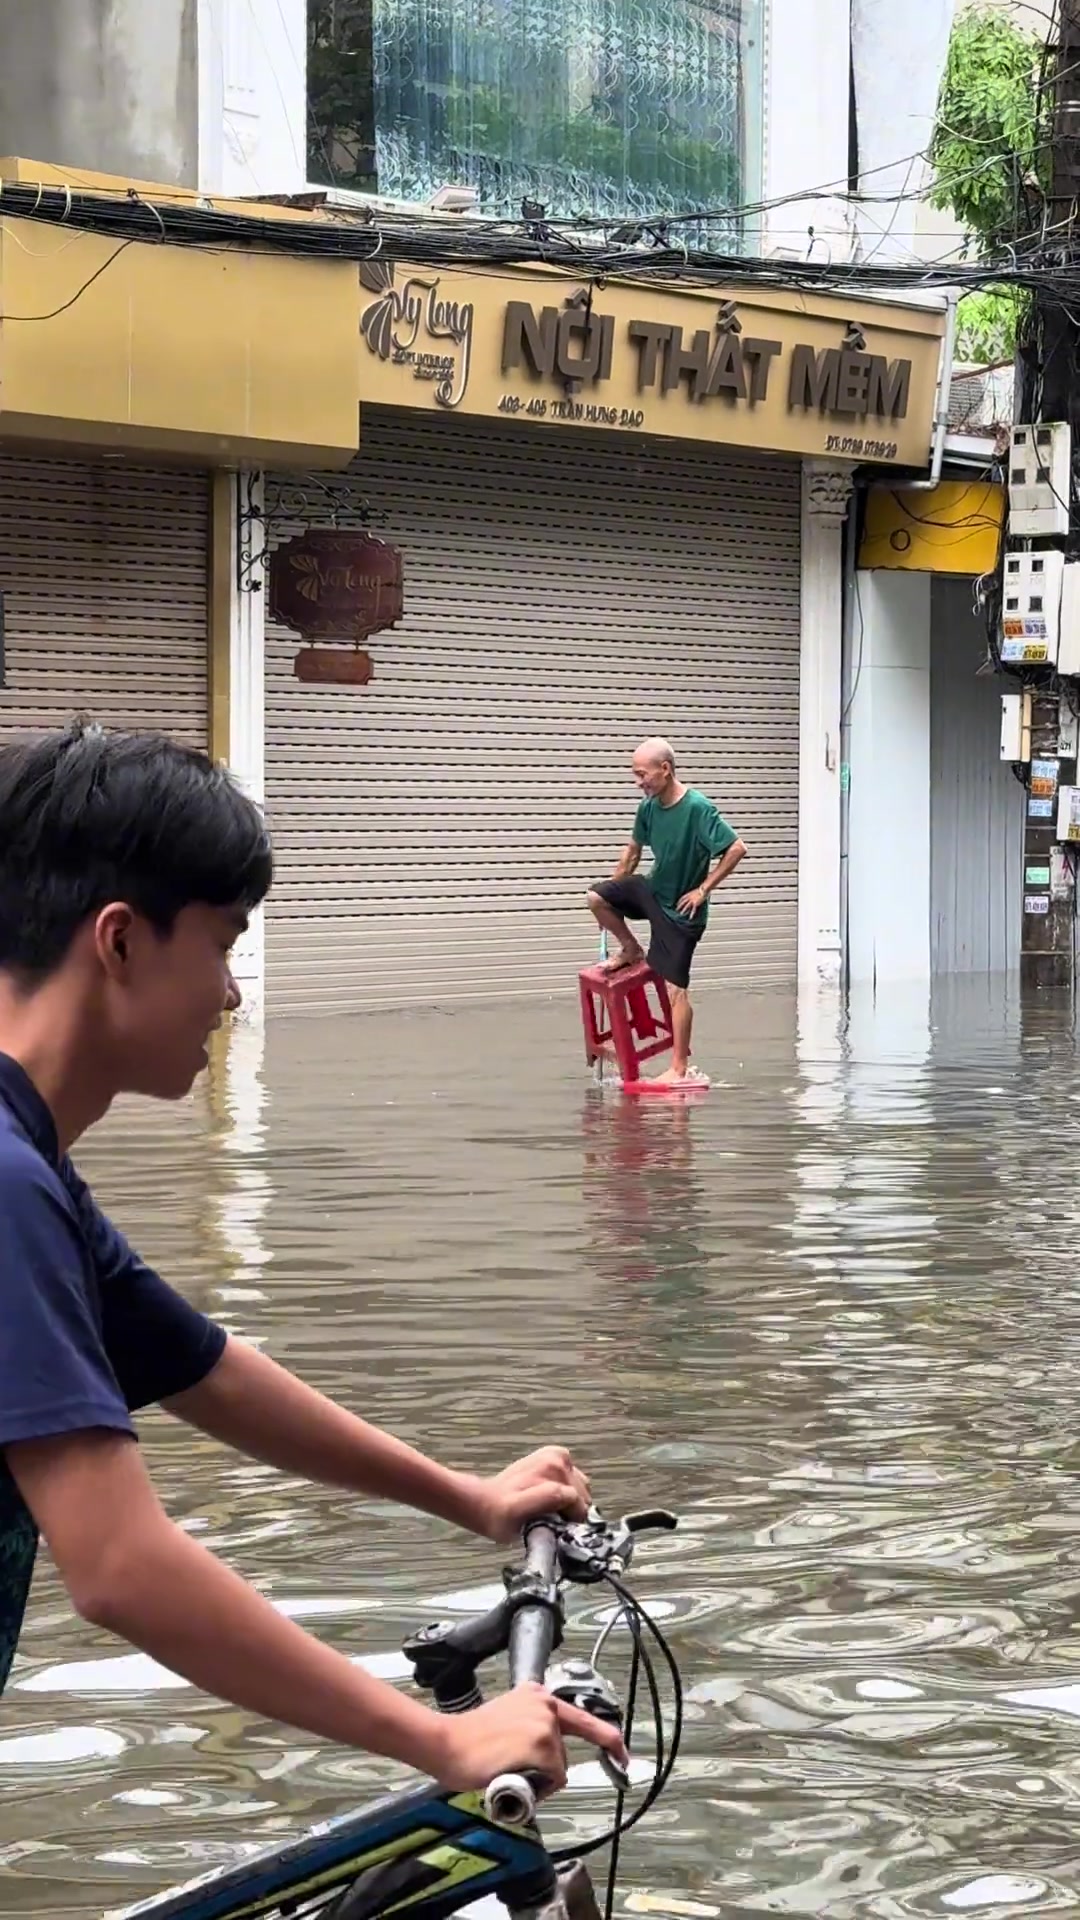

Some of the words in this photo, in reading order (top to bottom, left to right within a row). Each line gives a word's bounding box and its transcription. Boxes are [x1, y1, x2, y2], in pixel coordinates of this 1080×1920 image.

[501, 288, 615, 395] NỘI
[628, 300, 782, 402] THẤT
[789, 321, 912, 419] MỀM
